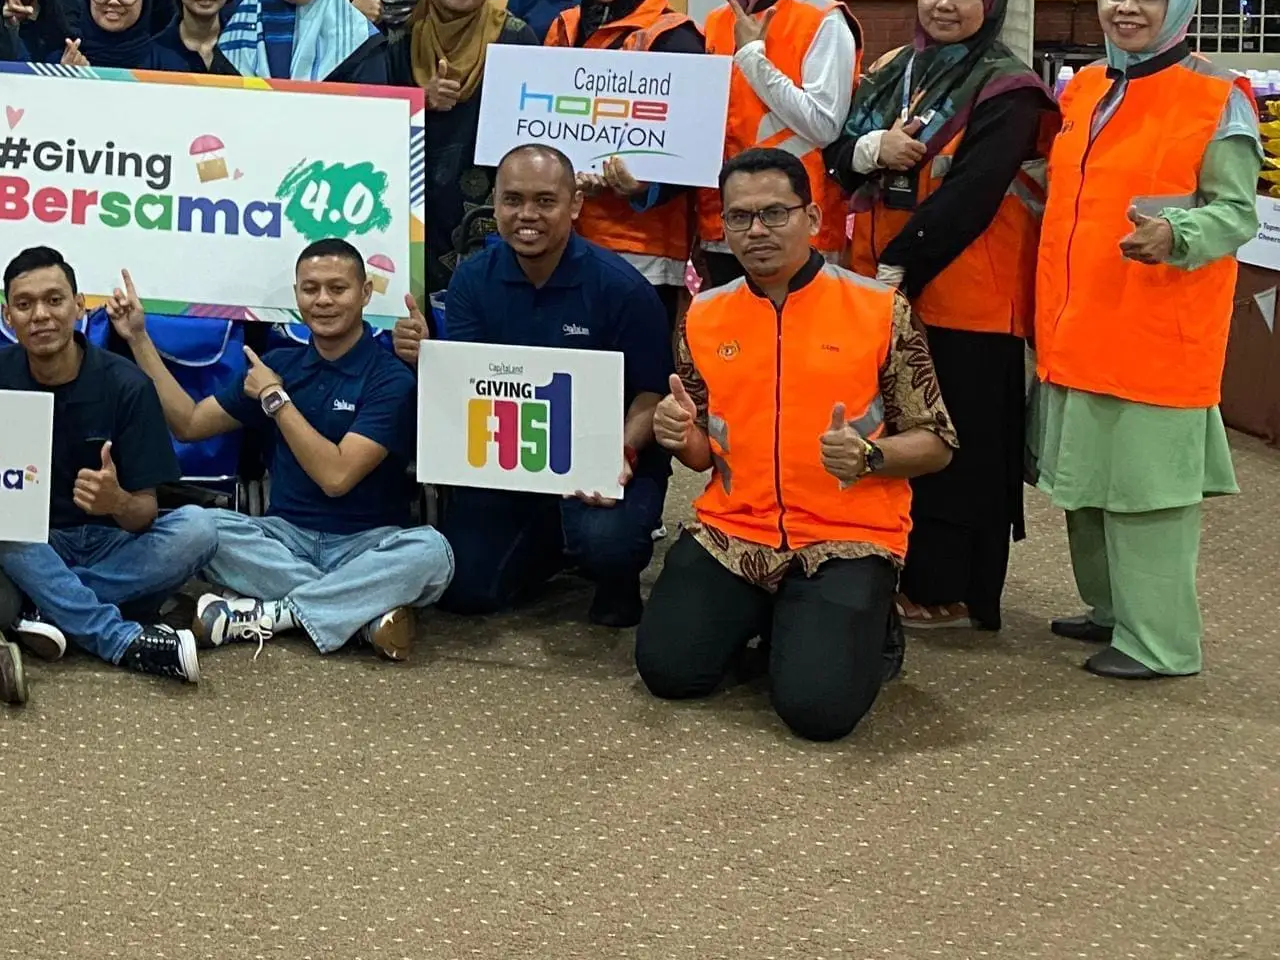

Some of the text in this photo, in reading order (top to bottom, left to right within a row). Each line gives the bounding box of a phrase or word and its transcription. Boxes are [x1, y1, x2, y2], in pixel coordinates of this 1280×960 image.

[519, 82, 669, 125] hope
[574, 67, 671, 97] CapitaLand
[299, 178, 375, 227] 4.0
